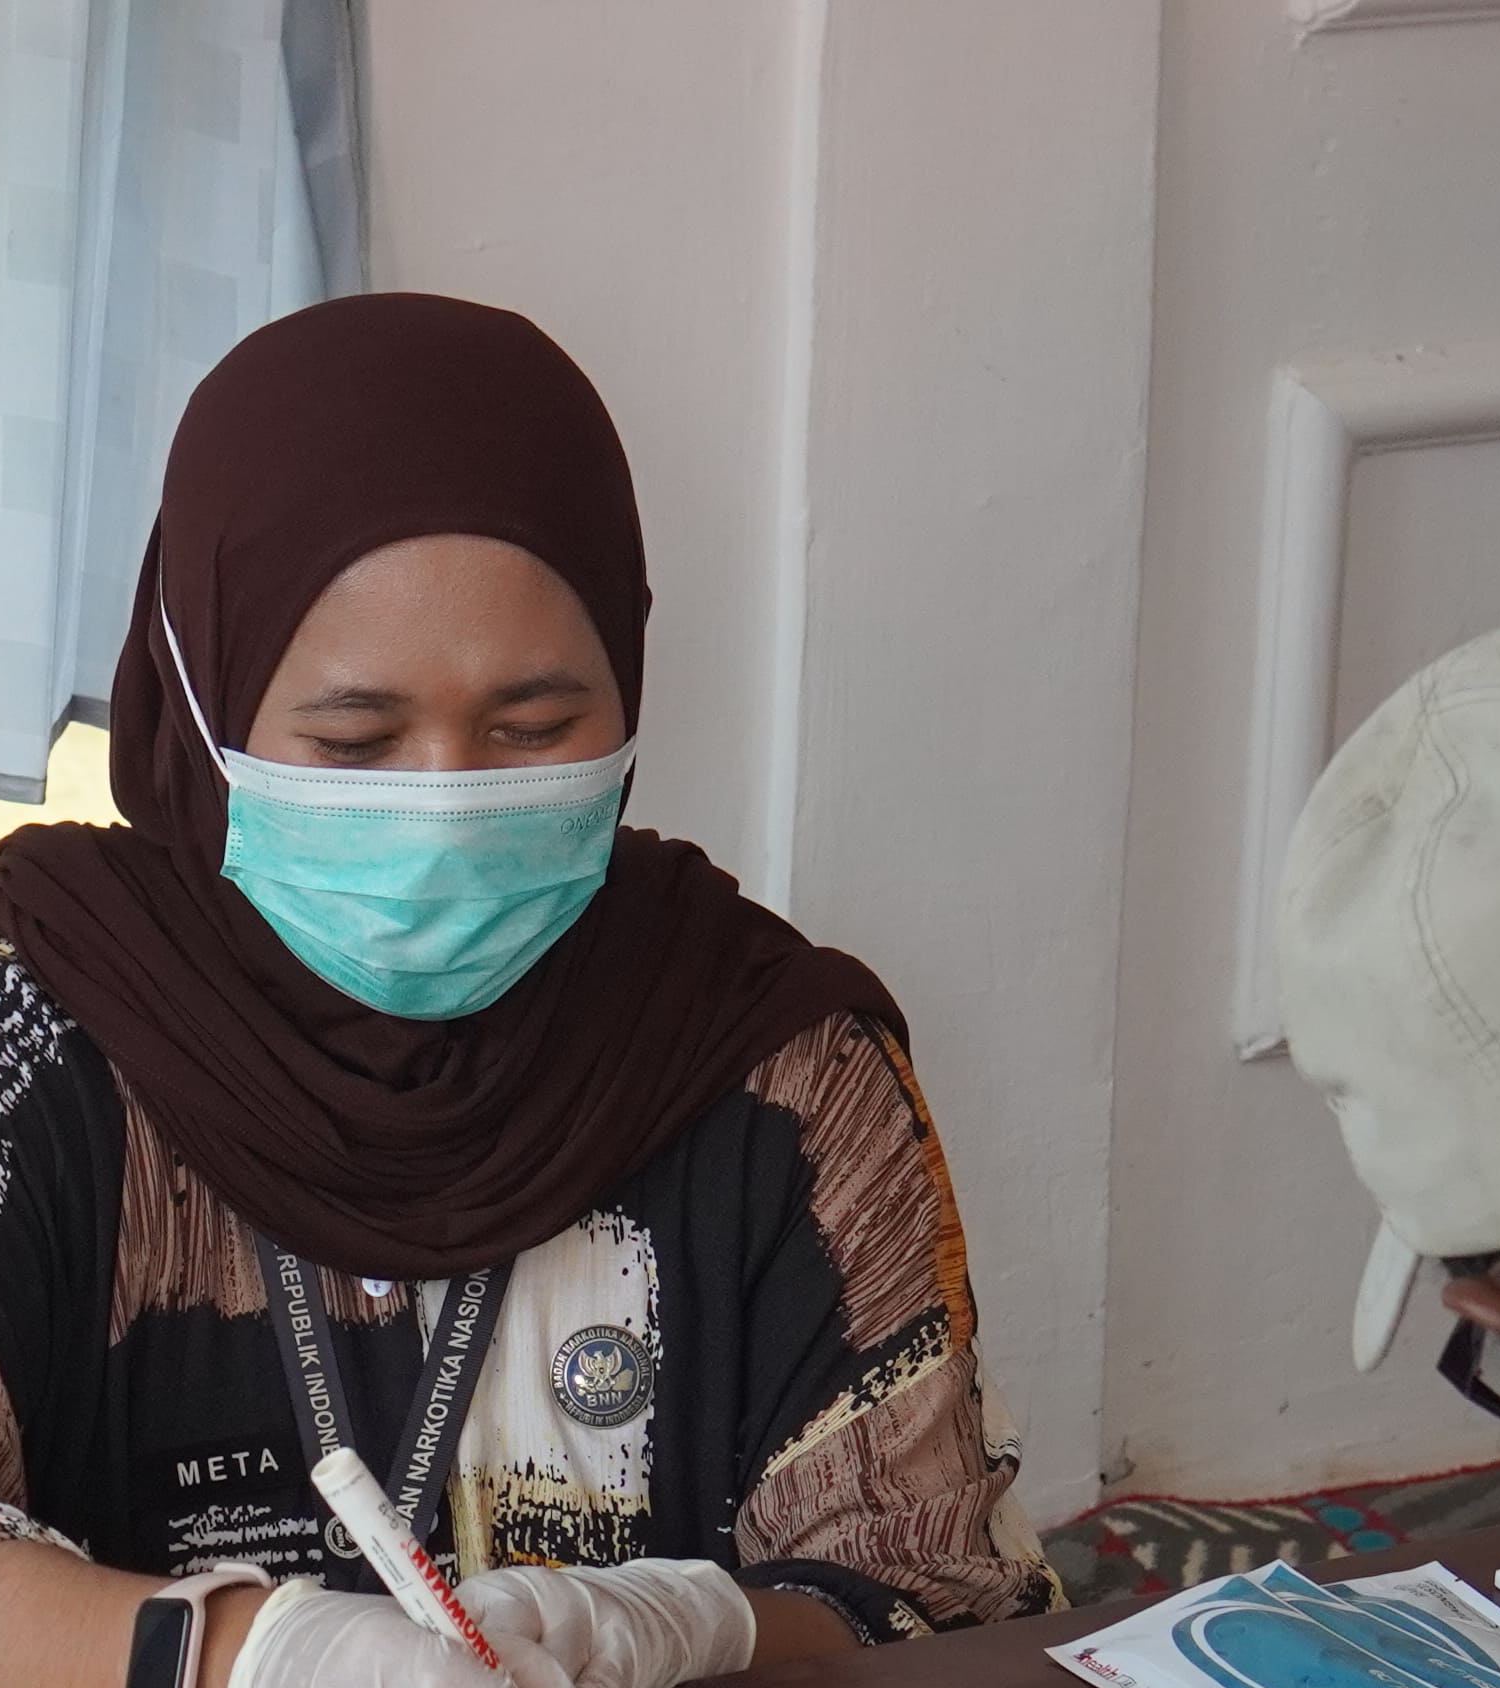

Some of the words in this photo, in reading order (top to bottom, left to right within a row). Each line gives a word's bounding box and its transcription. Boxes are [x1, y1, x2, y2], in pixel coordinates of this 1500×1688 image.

[276, 1253, 321, 1369] REPUBLIK
[562, 1327, 619, 1354] NARKOTIKA
[620, 1333, 651, 1380] NASIONAL
[406, 1354, 466, 1482] NARKOTIKA
[586, 1390, 624, 1408] BNN
[176, 1447, 280, 1488] META
[410, 1545, 501, 1671] SNOWMAN
